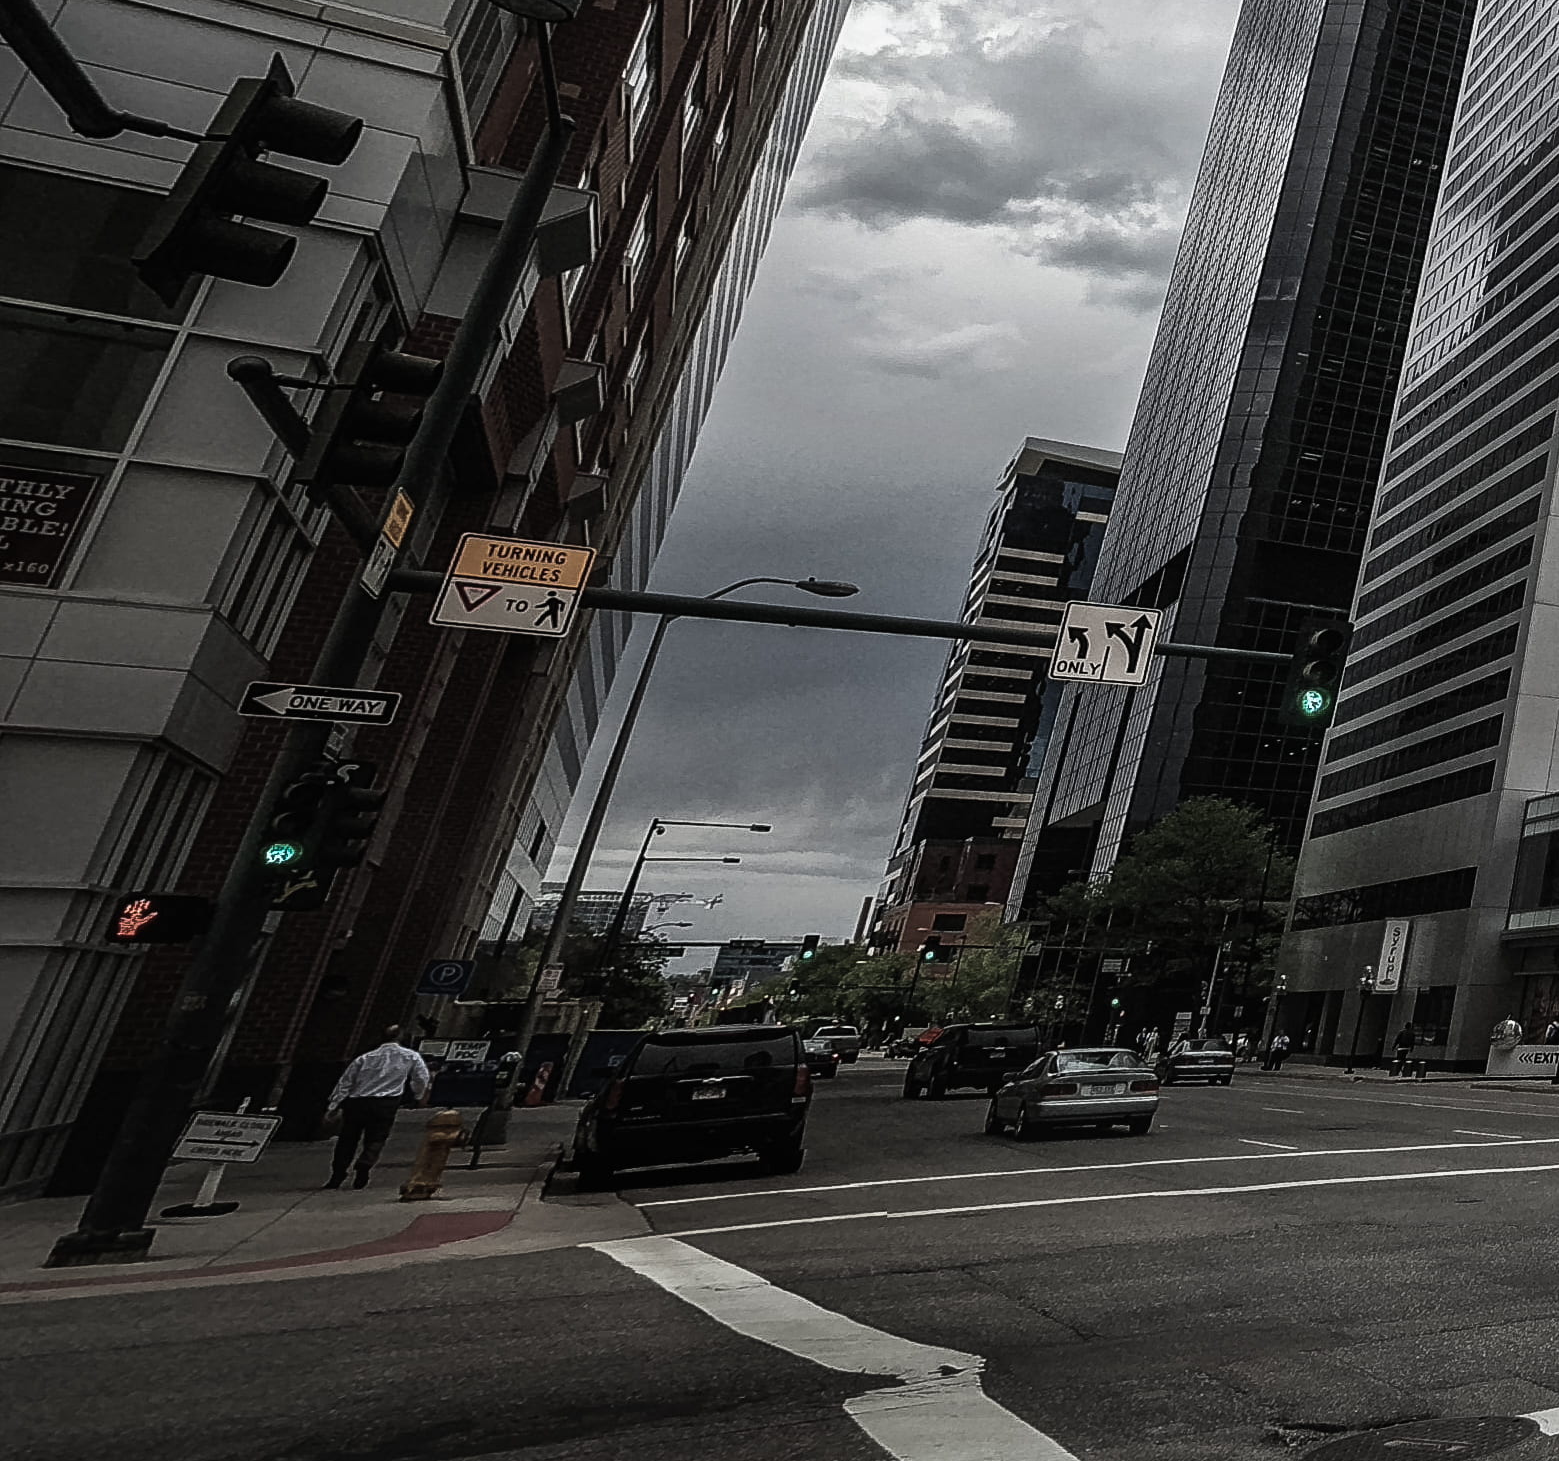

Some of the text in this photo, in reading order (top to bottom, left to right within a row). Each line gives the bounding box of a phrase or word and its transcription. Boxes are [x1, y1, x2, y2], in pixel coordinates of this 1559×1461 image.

[487, 544, 567, 565] TURNING
[481, 561, 562, 582] VEHICLES
[505, 599, 528, 612] TO
[1057, 660, 1101, 675] ONLY
[289, 695, 381, 713] ONE WAY
[454, 1042, 487, 1051] TEMP
[455, 1050, 479, 1059] FDC
[1534, 1052, 1559, 1064] EXIT
